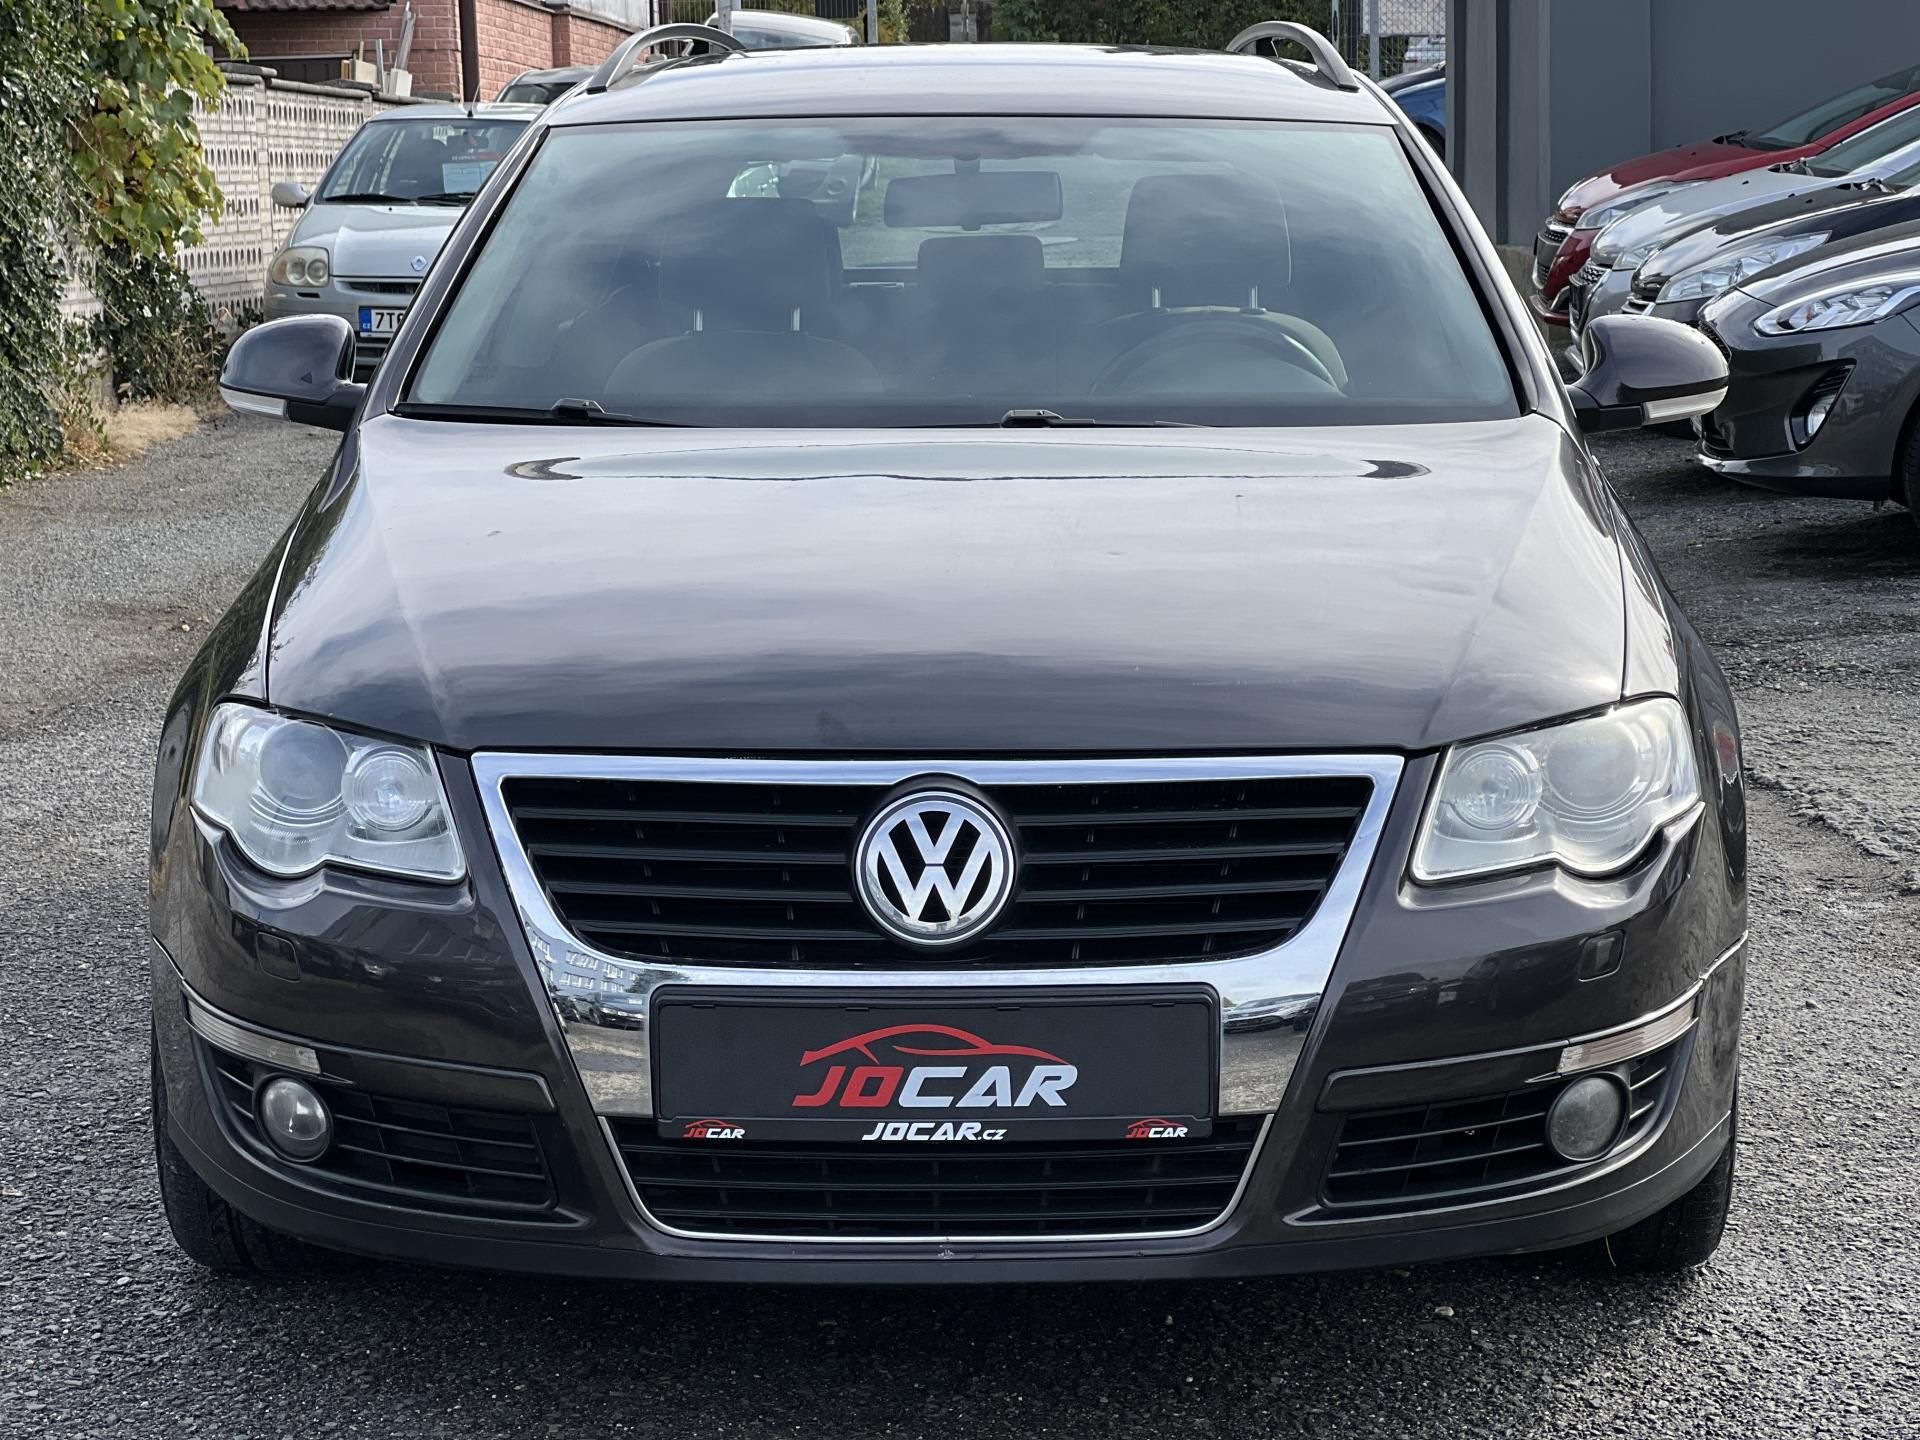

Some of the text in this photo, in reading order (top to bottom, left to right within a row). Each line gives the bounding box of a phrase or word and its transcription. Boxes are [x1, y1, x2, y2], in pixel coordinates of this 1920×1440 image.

[868, 801, 1002, 933] VW
[792, 1065, 1078, 1107] JOCAR
[683, 1128, 746, 1139] JOCAR
[862, 1122, 1008, 1141] JOCAR.cz
[1126, 1127, 1188, 1138] JOCAR
